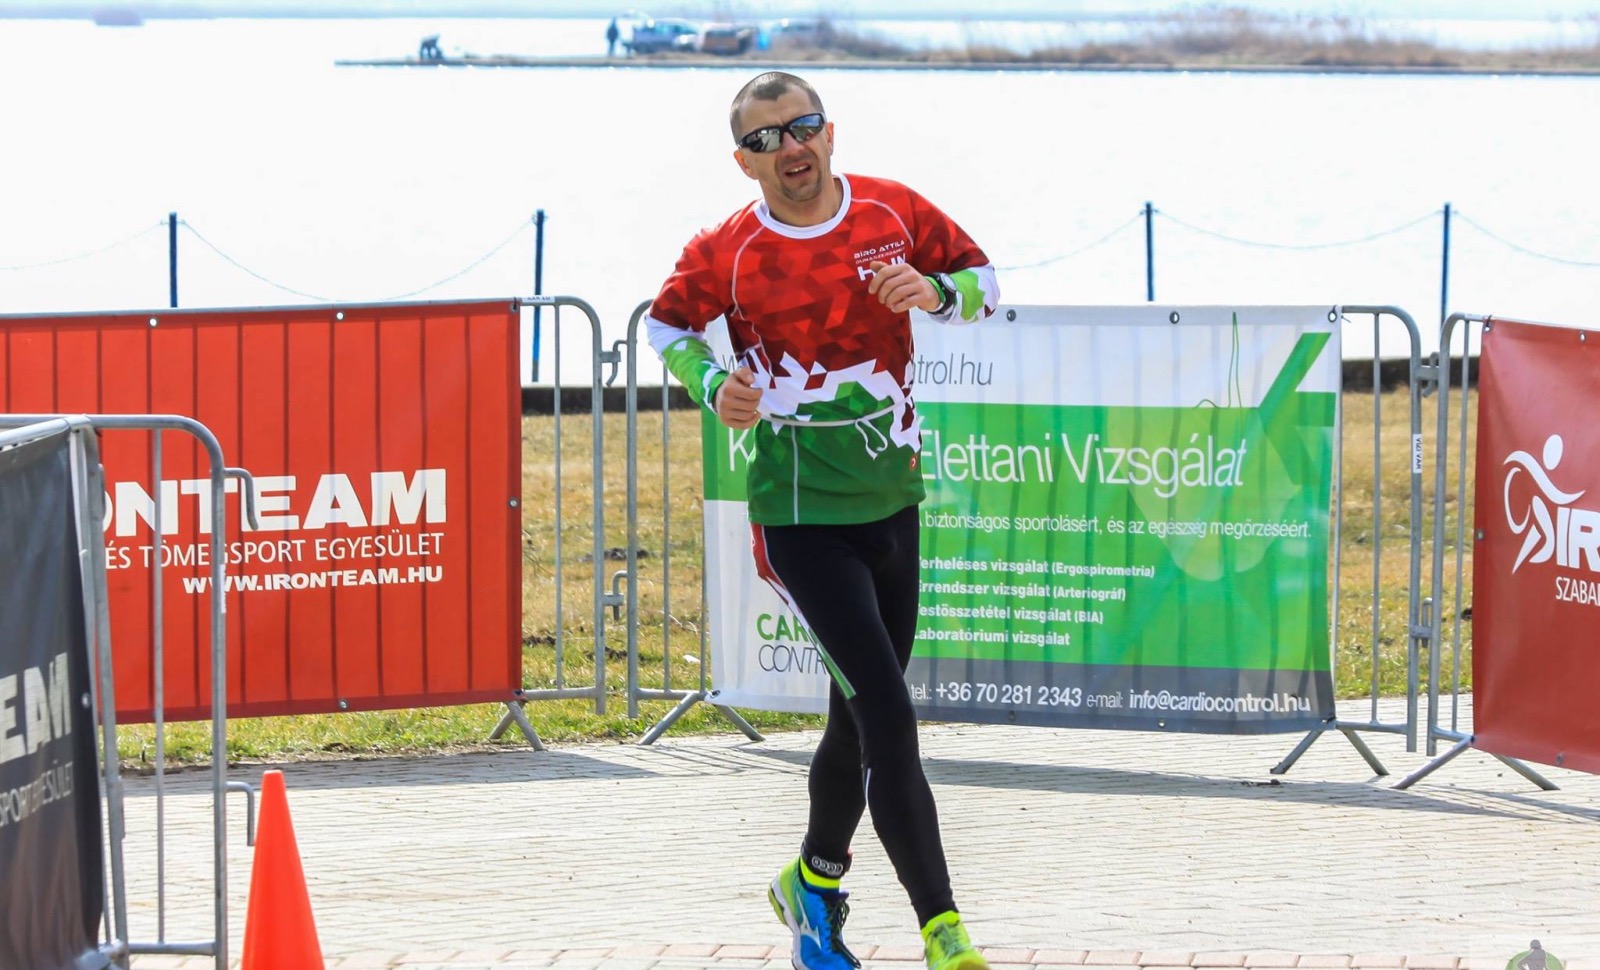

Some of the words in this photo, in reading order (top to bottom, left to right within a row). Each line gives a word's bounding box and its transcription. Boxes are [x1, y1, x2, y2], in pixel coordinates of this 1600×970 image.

[913, 353, 993, 385] trol.hu
[922, 416, 1054, 483] Élettani
[1062, 433, 1247, 498] Vizsgálat
[103, 468, 447, 536] NTEAM
[925, 511, 1010, 533] biztonságos
[1014, 514, 1102, 535] sportolásért,
[1107, 516, 1124, 533] és
[1128, 520, 1144, 534] az
[1150, 517, 1207, 538] egészség
[105, 540, 131, 569] ÉS
[139, 538, 306, 568] TÖMESPORT
[315, 529, 444, 561] EGYESÜLET
[919, 556, 987, 571] erheléses
[991, 559, 1048, 574] vizsgálat
[1052, 562, 1155, 579] (Ergospirometria)
[993, 582, 1050, 598] vizsgálat
[1053, 586, 1126, 602] (Arteriográf)
[1555, 576, 1600, 607] SZABA
[918, 604, 1010, 619] estösszetétel
[1014, 607, 1071, 624] vizsgálat
[1074, 611, 1104, 625] (BIA)
[1012, 630, 1070, 647] vizsgálat
[936, 682, 972, 702] +36
[976, 683, 998, 703] 70
[1001, 684, 1032, 705] 281
[1037, 686, 1082, 708] 2343
[1130, 689, 1311, 712] info@cardiocontrol.hu
